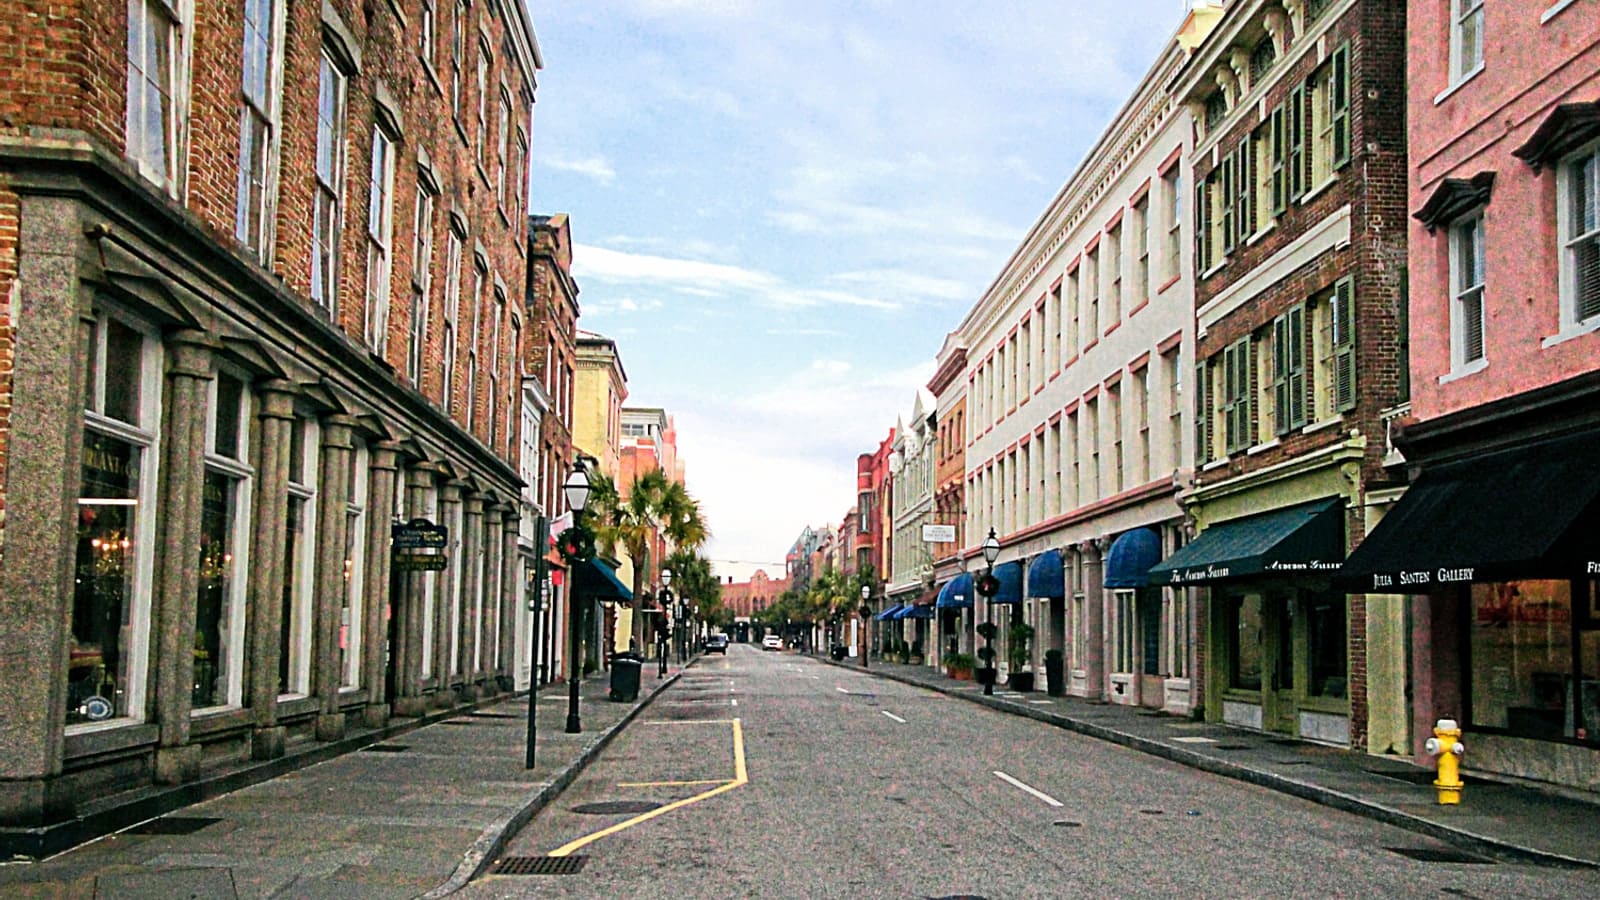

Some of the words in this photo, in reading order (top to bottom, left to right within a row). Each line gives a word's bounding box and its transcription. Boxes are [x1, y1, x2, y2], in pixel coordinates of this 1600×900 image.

[1373, 574, 1393, 590] JULIA
[1400, 571, 1430, 585] SANTEN
[1437, 568, 1474, 582] GALLERY
